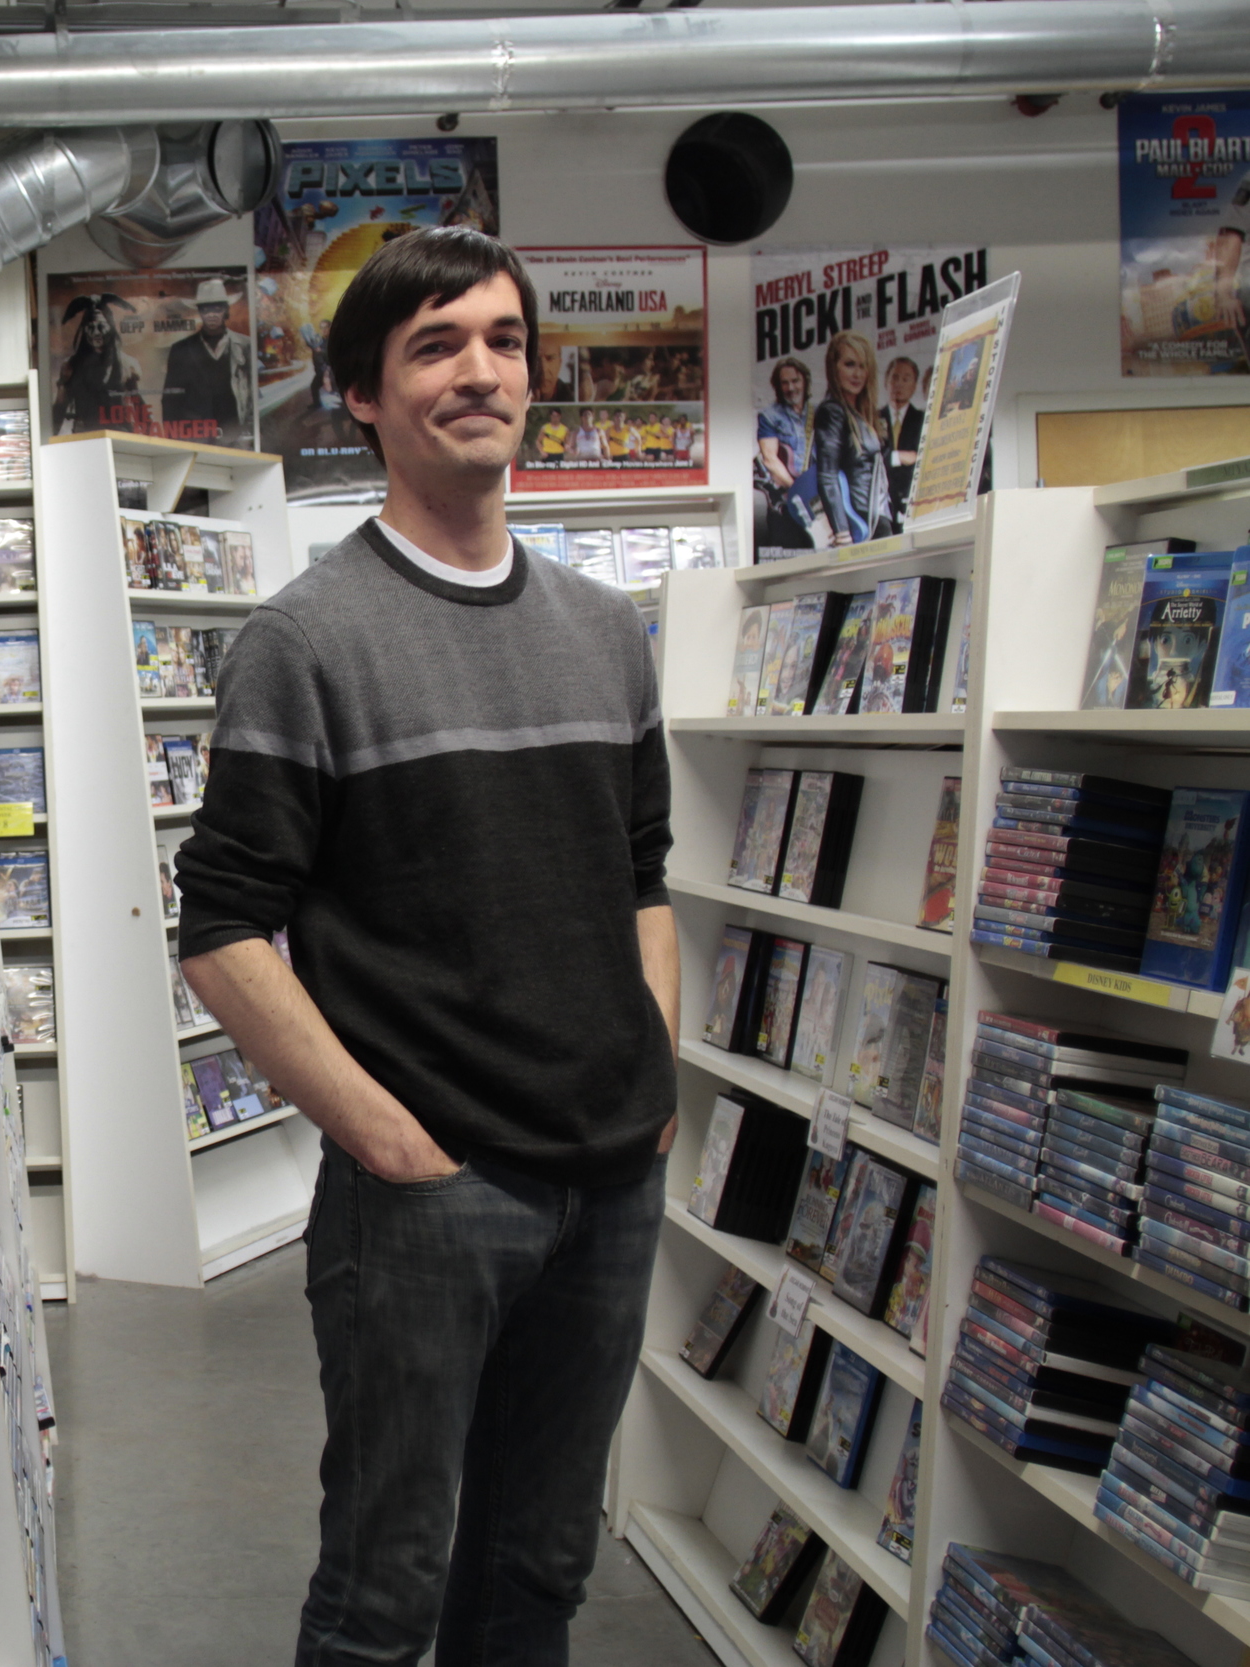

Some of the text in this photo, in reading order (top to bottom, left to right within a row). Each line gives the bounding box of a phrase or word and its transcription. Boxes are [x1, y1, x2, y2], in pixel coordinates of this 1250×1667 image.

[1162, 103, 1227, 113] KEVIN JAMES
[1135, 136, 1250, 163] PAUL BLART
[287, 159, 465, 199] PIXELS
[755, 250, 890, 309] MERYL STREEP
[549, 290, 668, 313] MCFARLAND USA
[756, 248, 988, 363] RICKI FLASH
[120, 319, 197, 334] DEPP HAMMER
[100, 405, 153, 424] LONE
[134, 419, 218, 440] RANGER
[1161, 602, 1203, 623] Arrietty
[170, 756, 194, 778] LUCY
[1184, 810, 1221, 824] MONSTERS
[1184, 822, 1217, 832] UNIVERSITY
[1088, 973, 1132, 993] DISNEY KIDS
[824, 1109, 832, 1120] The
[832, 1112, 841, 1124] Tale
[797, 1203, 830, 1230] FOREVER
[1165, 1264, 1195, 1286] DUMBO
